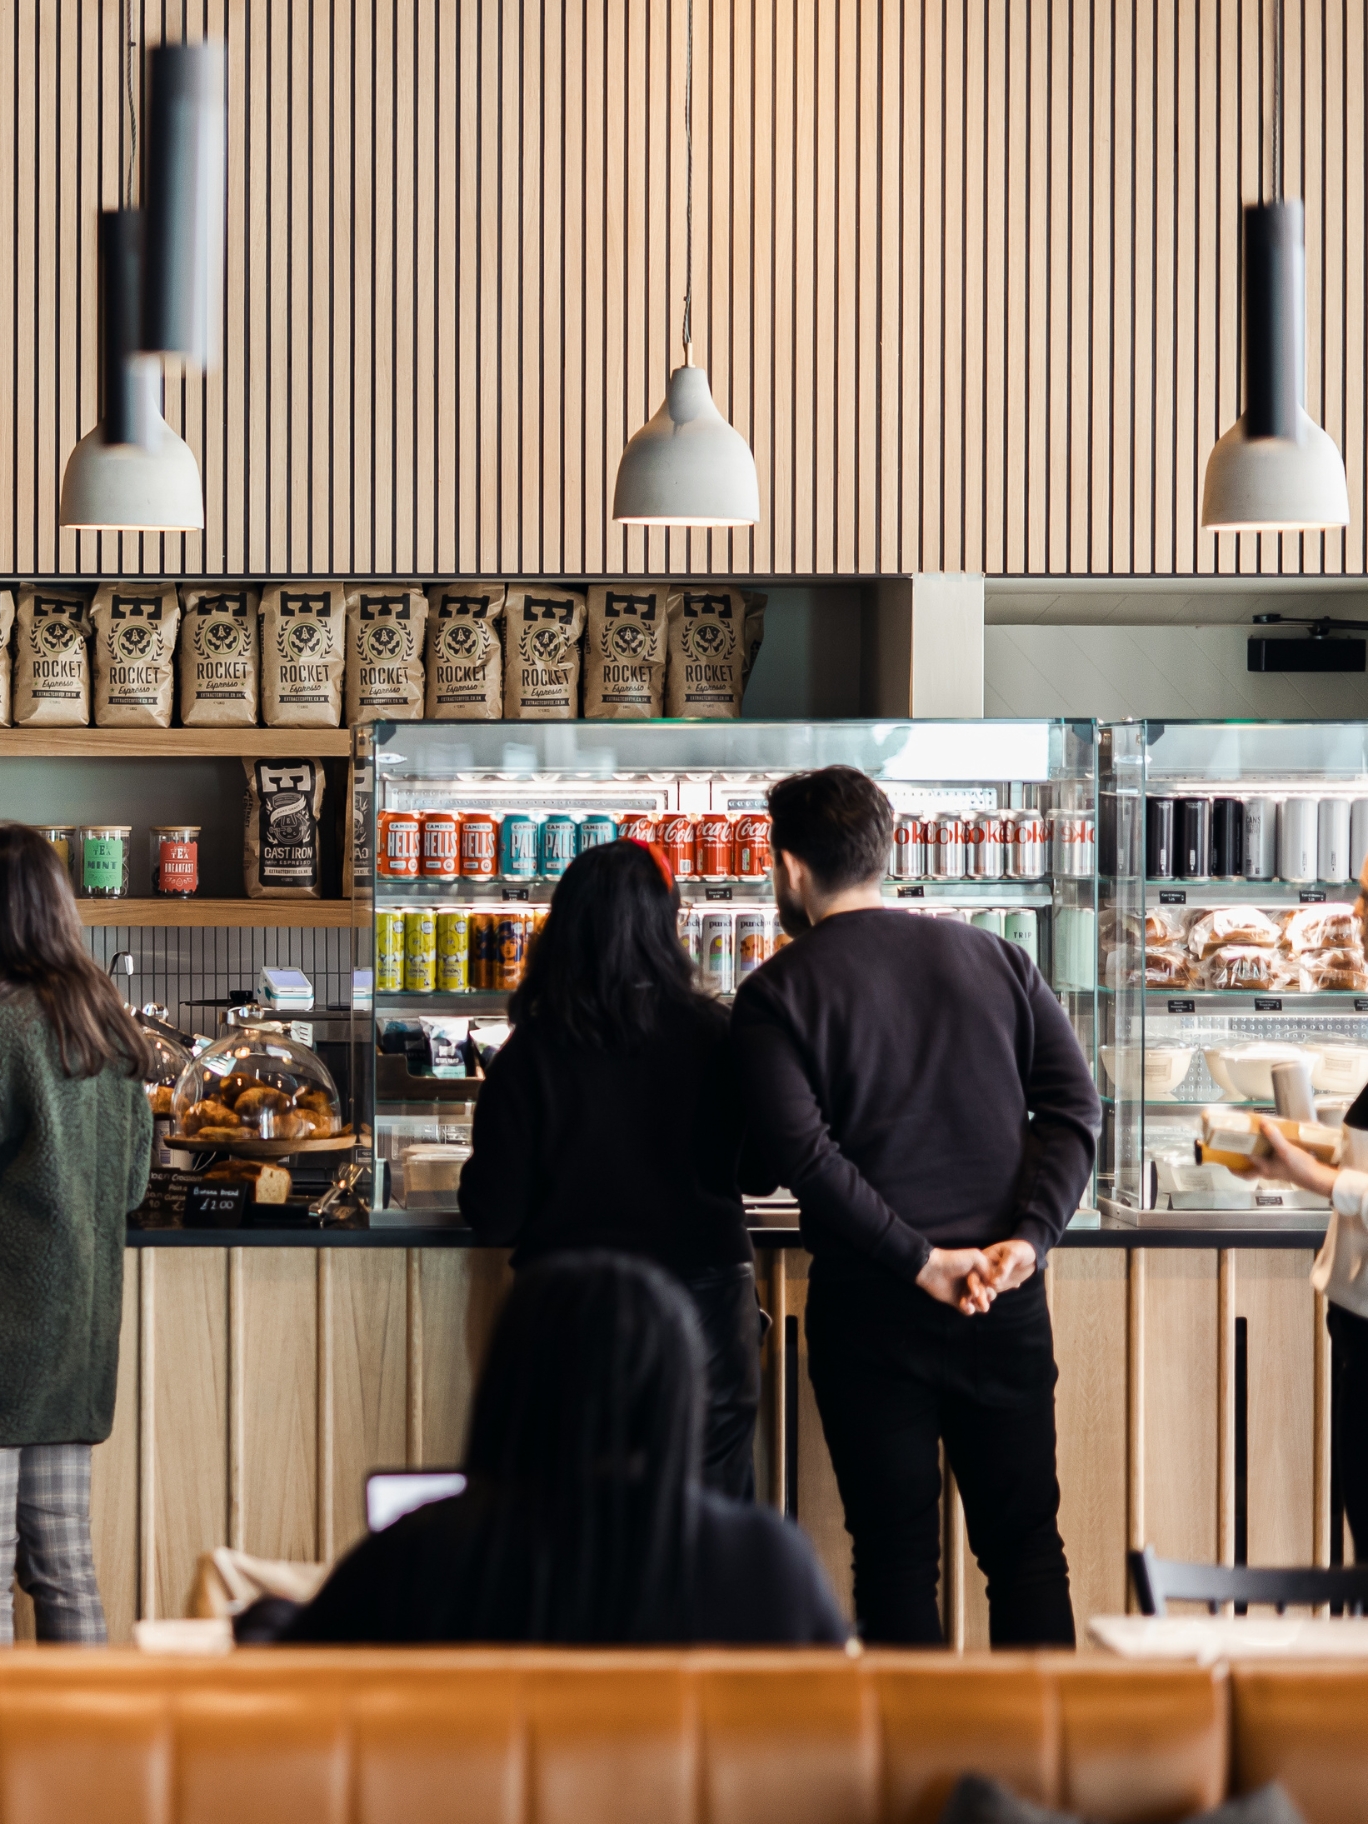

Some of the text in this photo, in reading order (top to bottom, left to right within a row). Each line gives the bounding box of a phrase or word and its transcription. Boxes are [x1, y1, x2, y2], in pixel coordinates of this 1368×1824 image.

[33, 660, 82, 678] ROCKET
[109, 666, 160, 684] ROCKET
[197, 662, 248, 679] ROCKET
[280, 665, 329, 683] ROCKET
[436, 664, 487, 683] ROCKET
[603, 664, 653, 683] ROCKET
[685, 664, 733, 682] ROCKET
[360, 667, 409, 685] ROCKET
[522, 668, 570, 686] ROCKET
[42, 679, 74, 689] Espresso
[118, 685, 151, 695] Espresso
[206, 680, 238, 690] Espresso
[289, 683, 322, 694] Espresso
[445, 684, 478, 694] Espresso
[611, 684, 644, 693] Espresso
[695, 683, 726, 693] Espresso
[369, 686, 401, 696] Espresso
[530, 687, 562, 697] Espresso
[93, 845, 111, 856] TEA
[387, 832, 420, 858] HELLS
[424, 832, 457, 858] HELLS
[462, 832, 495, 858] HELLS
[544, 833, 576, 858] PALE
[171, 848, 189, 859] TEA
[264, 846, 313, 859] CAST IRON
[87, 861, 117, 869] MINT
[164, 863, 194, 873] BREAKFAST
[1013, 931, 1032, 939] TRIP
